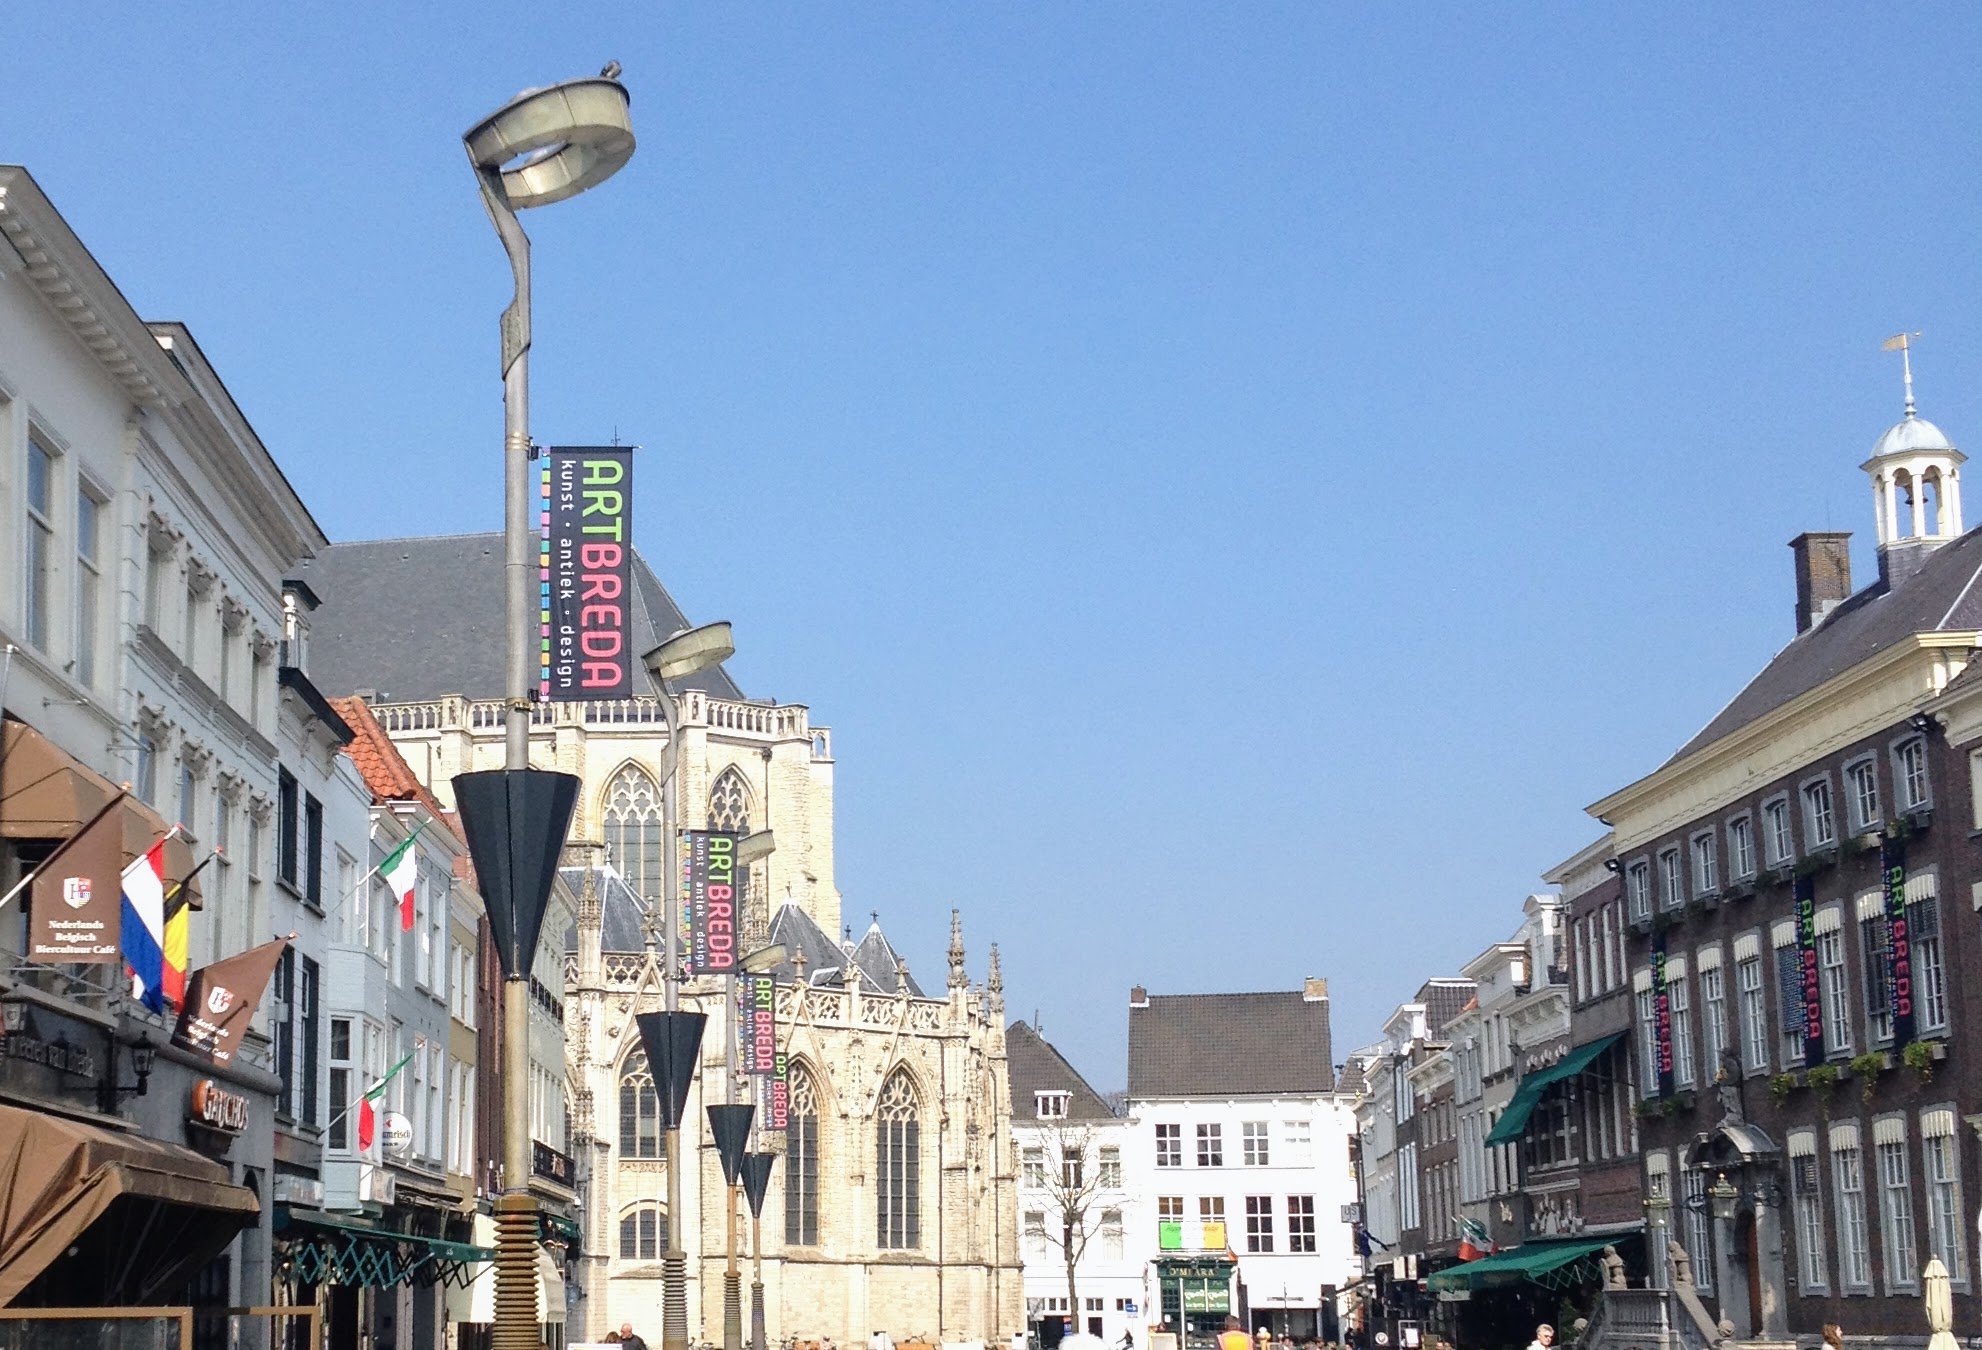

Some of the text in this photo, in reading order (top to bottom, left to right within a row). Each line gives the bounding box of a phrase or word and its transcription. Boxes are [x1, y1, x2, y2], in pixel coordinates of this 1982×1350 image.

[556, 460, 577, 688] kunst antiek design
[581, 460, 624, 688] ARTBREDA
[696, 836, 706, 866] kunst
[48, 920, 105, 929] Nederlands
[55, 932, 97, 943] Belgisch
[708, 837, 733, 968] ARTBREDA
[35, 945, 116, 954] Biercultuur Café
[695, 931, 706, 968] design
[1802, 899, 1821, 1039] ARTBREDA
[1891, 865, 1912, 1017] ARTBREDA
[755, 977, 774, 1070] ARTBREDA
[1657, 951, 1672, 1072] ARTBREDA
[746, 1044, 754, 1070] design
[773, 1055, 788, 1127] ARTBREDA
[203, 1080, 250, 1131] GAUCHOS
